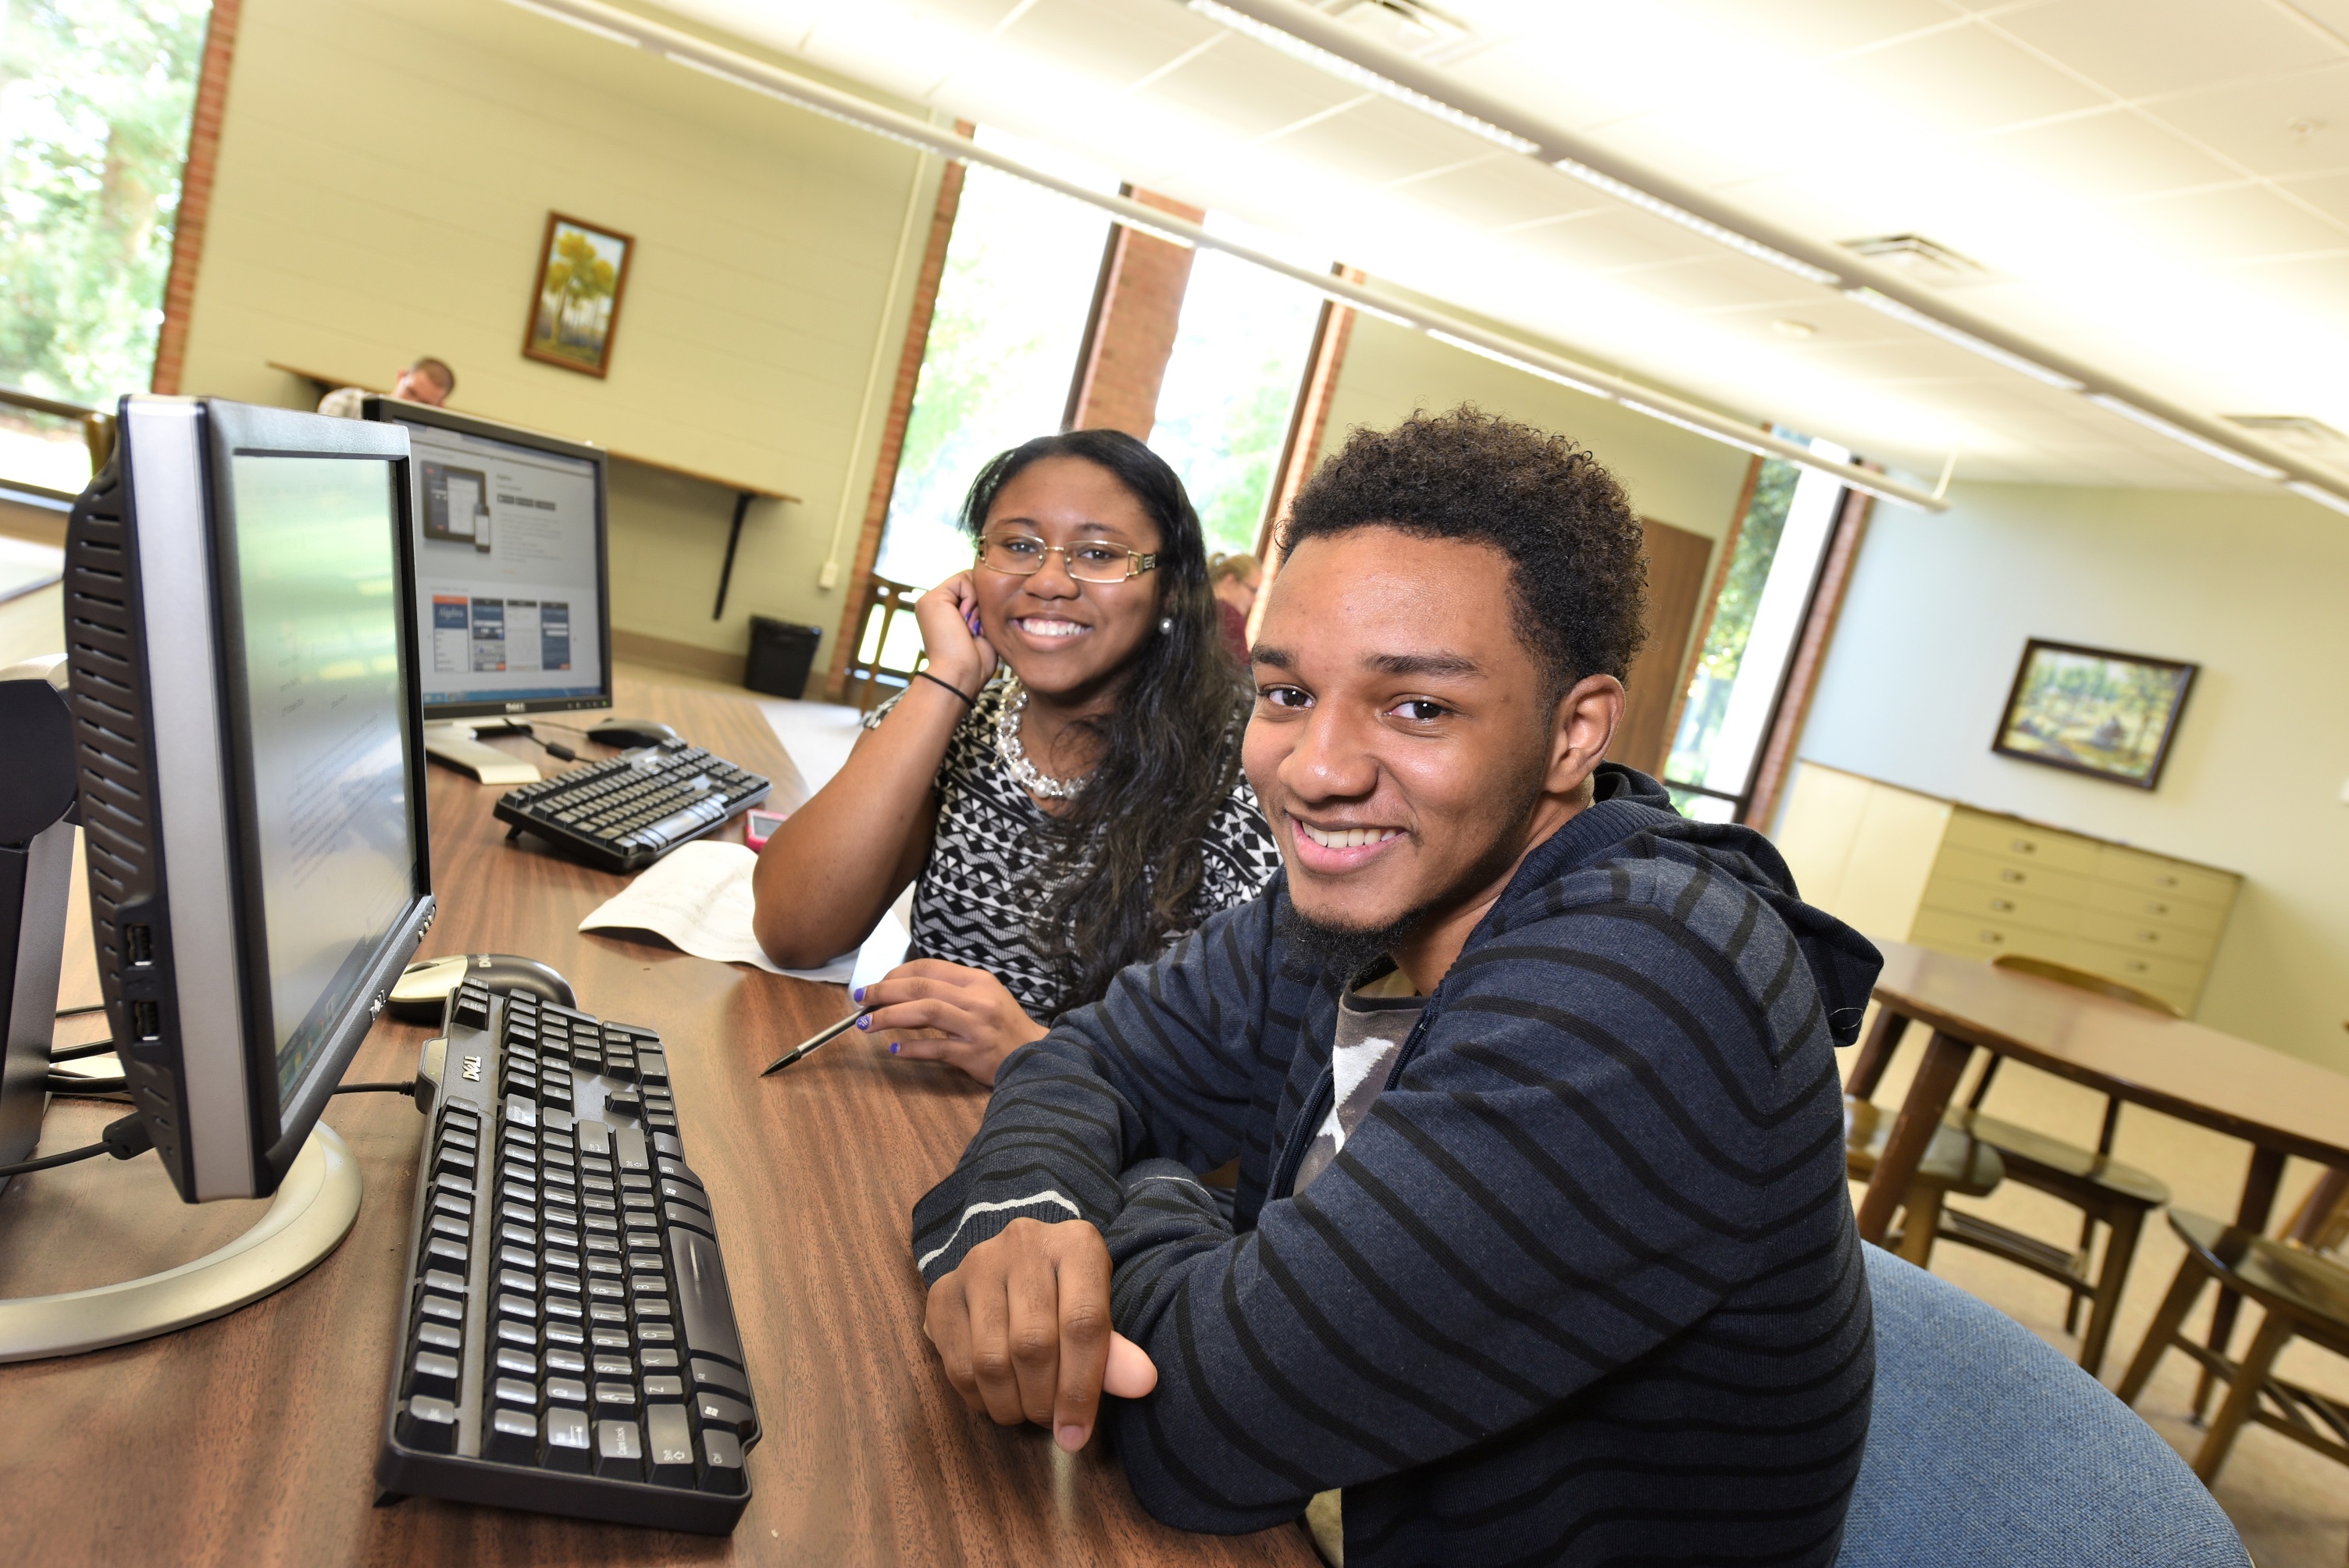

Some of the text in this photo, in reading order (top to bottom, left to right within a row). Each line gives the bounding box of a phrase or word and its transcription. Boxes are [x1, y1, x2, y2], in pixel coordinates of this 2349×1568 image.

[369, 989, 387, 1021] DELL
[462, 1056, 482, 1082] DELL
[551, 1357, 565, 1366] W
[552, 1388, 569, 1397] Q
[616, 1427, 628, 1456] Caps Lock
[663, 1449, 674, 1462] Shift
[712, 1452, 723, 1464] Ctrl
